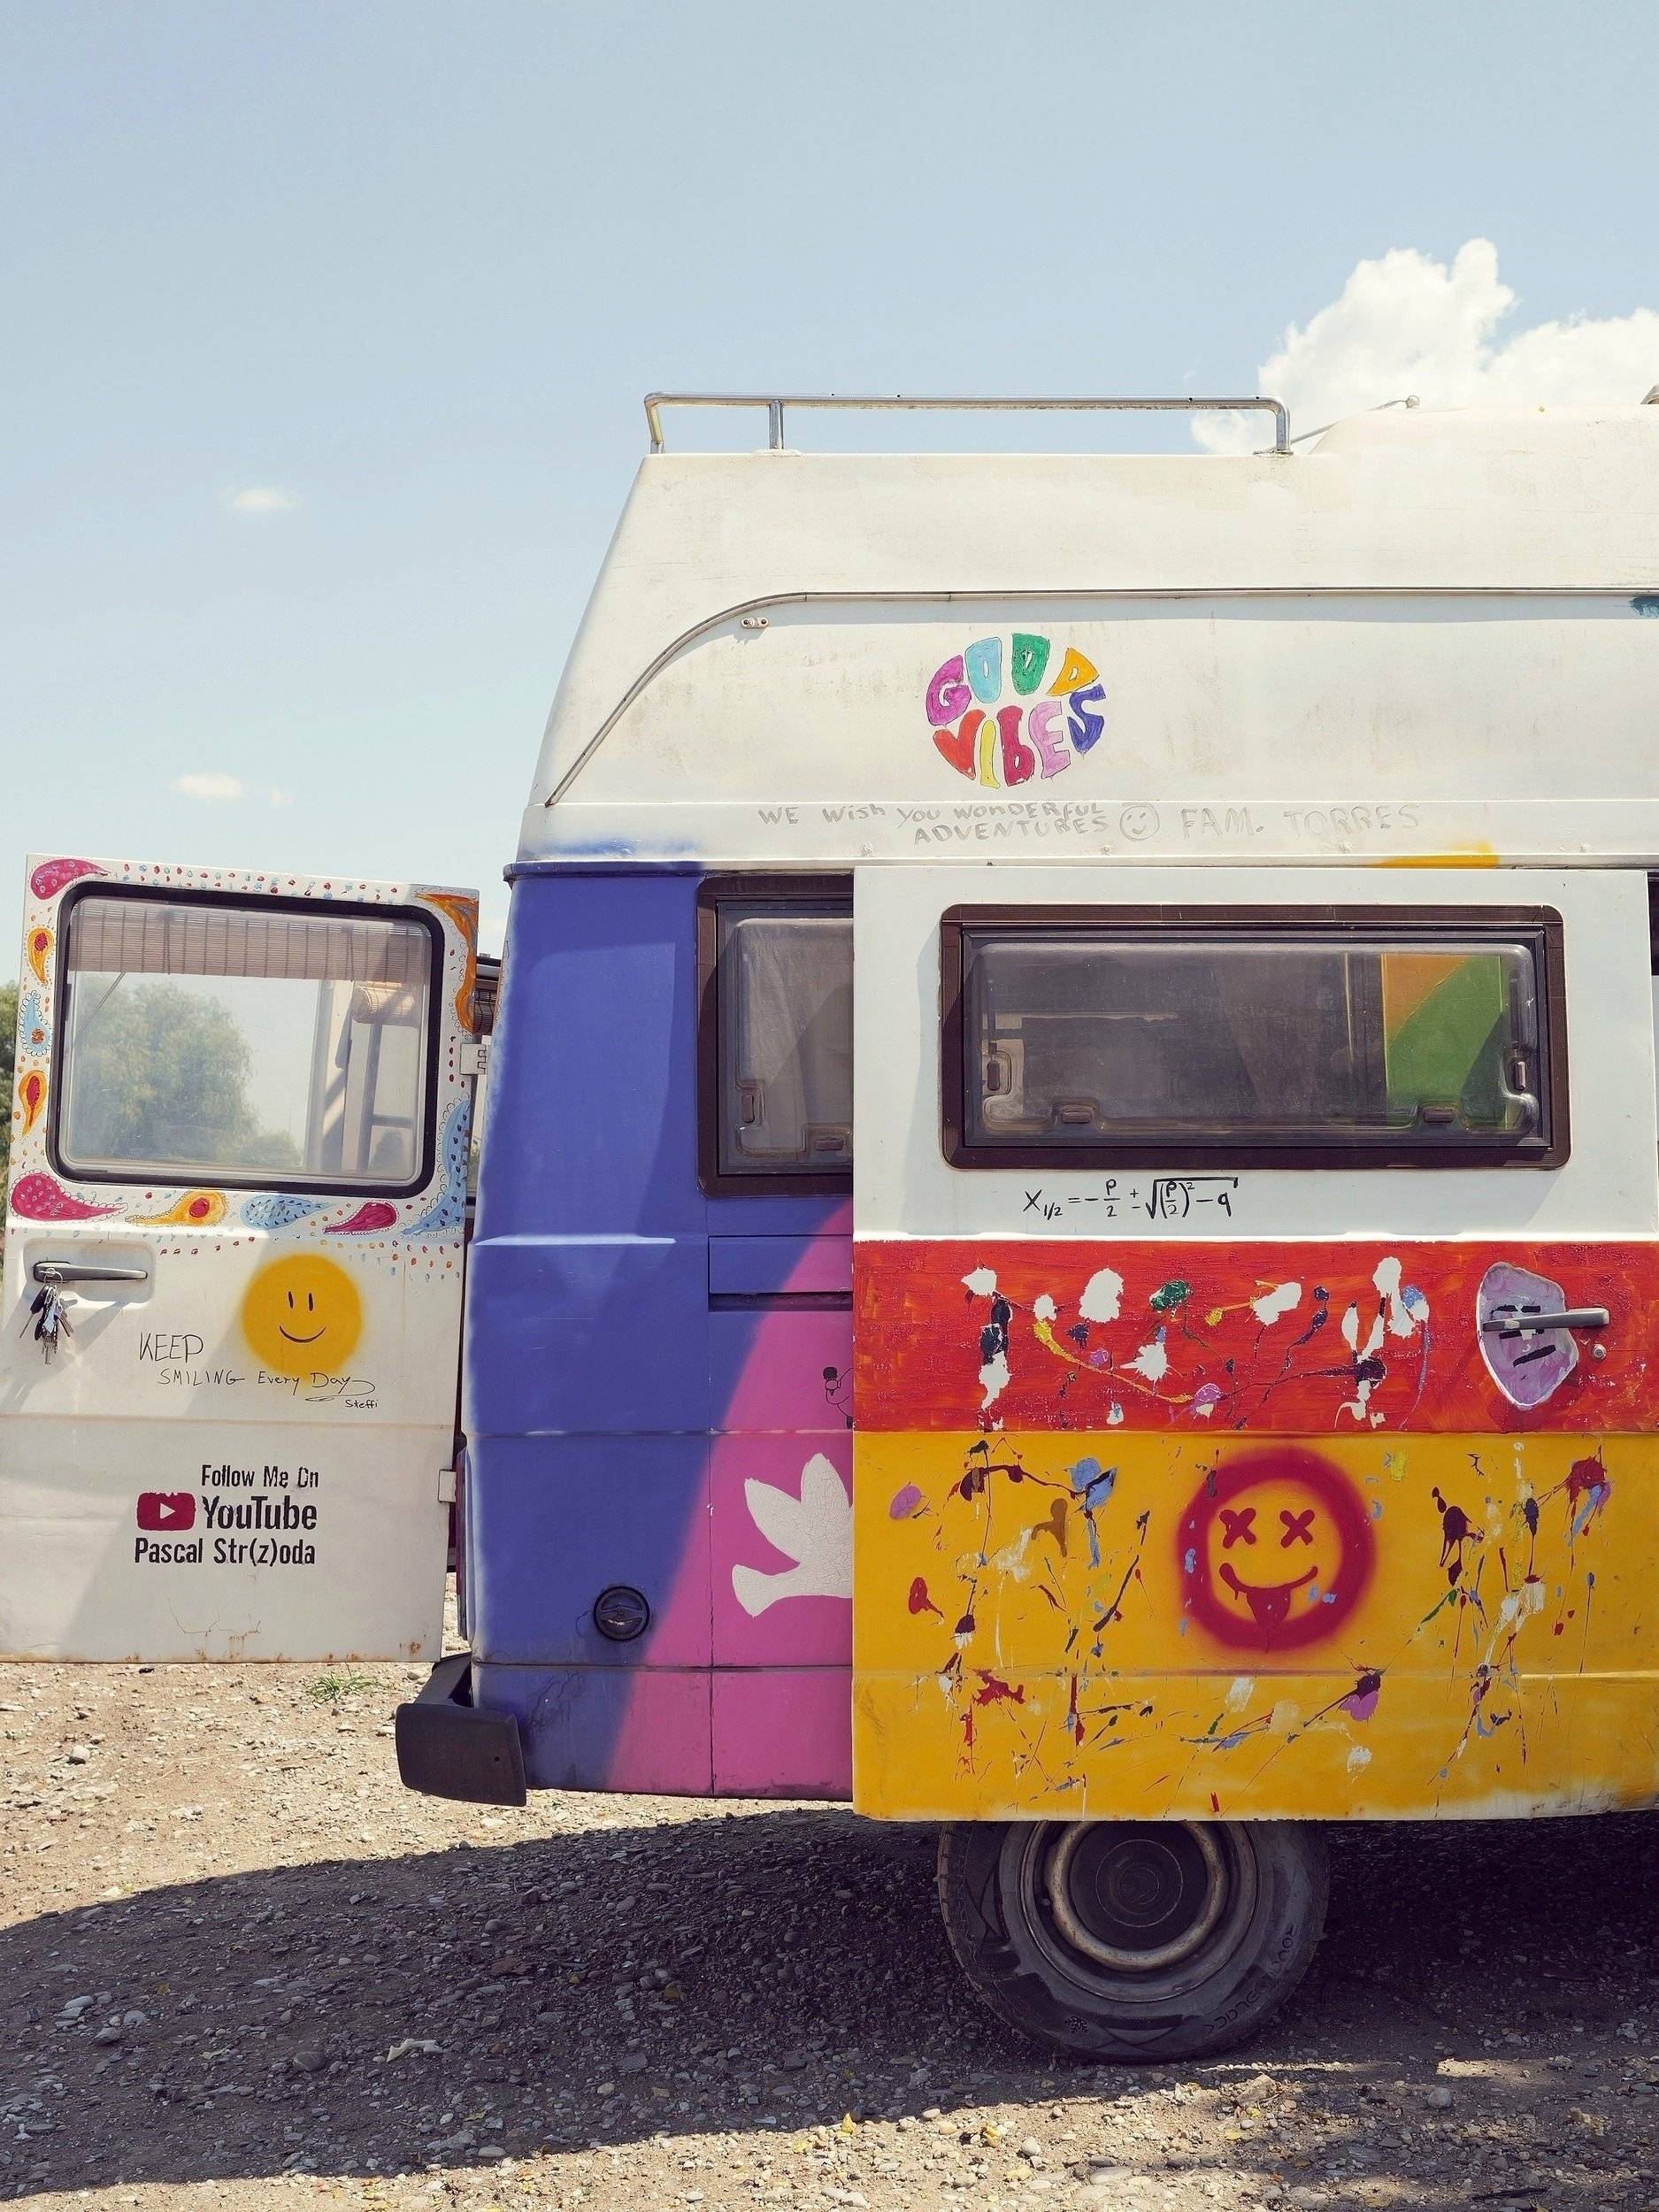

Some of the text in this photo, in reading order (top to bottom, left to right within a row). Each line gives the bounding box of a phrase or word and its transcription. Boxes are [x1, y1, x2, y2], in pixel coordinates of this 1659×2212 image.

[926, 632, 1100, 726] GOOD
[757, 806, 799, 826] WE
[914, 816, 1109, 846] ADVENTURES
[1180, 804, 1420, 841] FAM. TORRES
[139, 1332, 204, 1363] KEEP
[157, 1368, 351, 1395] SMILING Every Day
[202, 1464, 255, 1487] Follow
[264, 1465, 288, 1488] Me
[201, 1494, 318, 1531] YouTube
[134, 1537, 316, 1567] Pascal Str(z)oda
